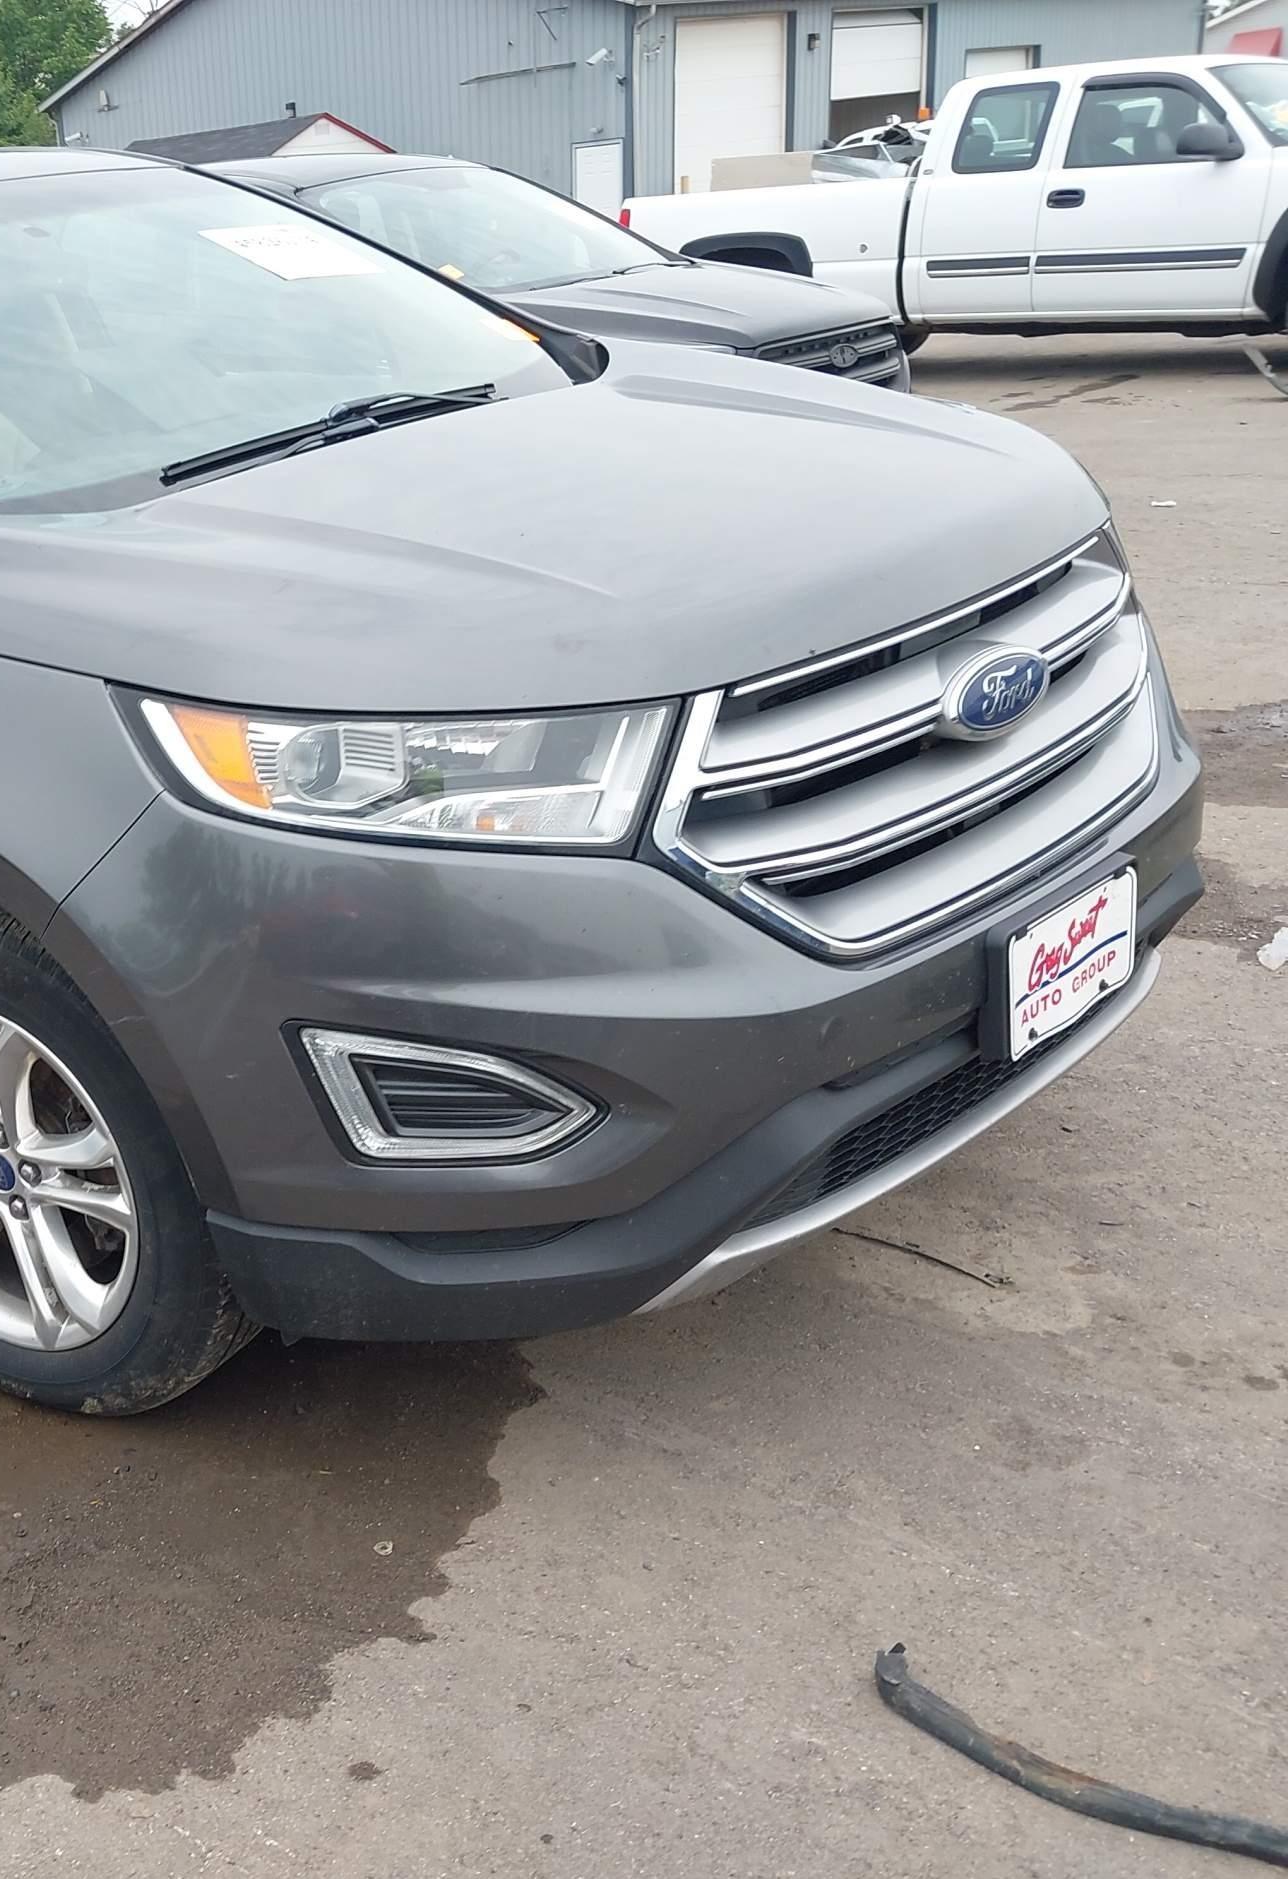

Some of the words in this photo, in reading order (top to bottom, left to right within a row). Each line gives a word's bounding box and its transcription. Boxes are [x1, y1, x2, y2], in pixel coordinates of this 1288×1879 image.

[982, 665, 1035, 720] Ford
[1021, 988, 1062, 1027] AUTO
[1072, 949, 1116, 993] GROUP
